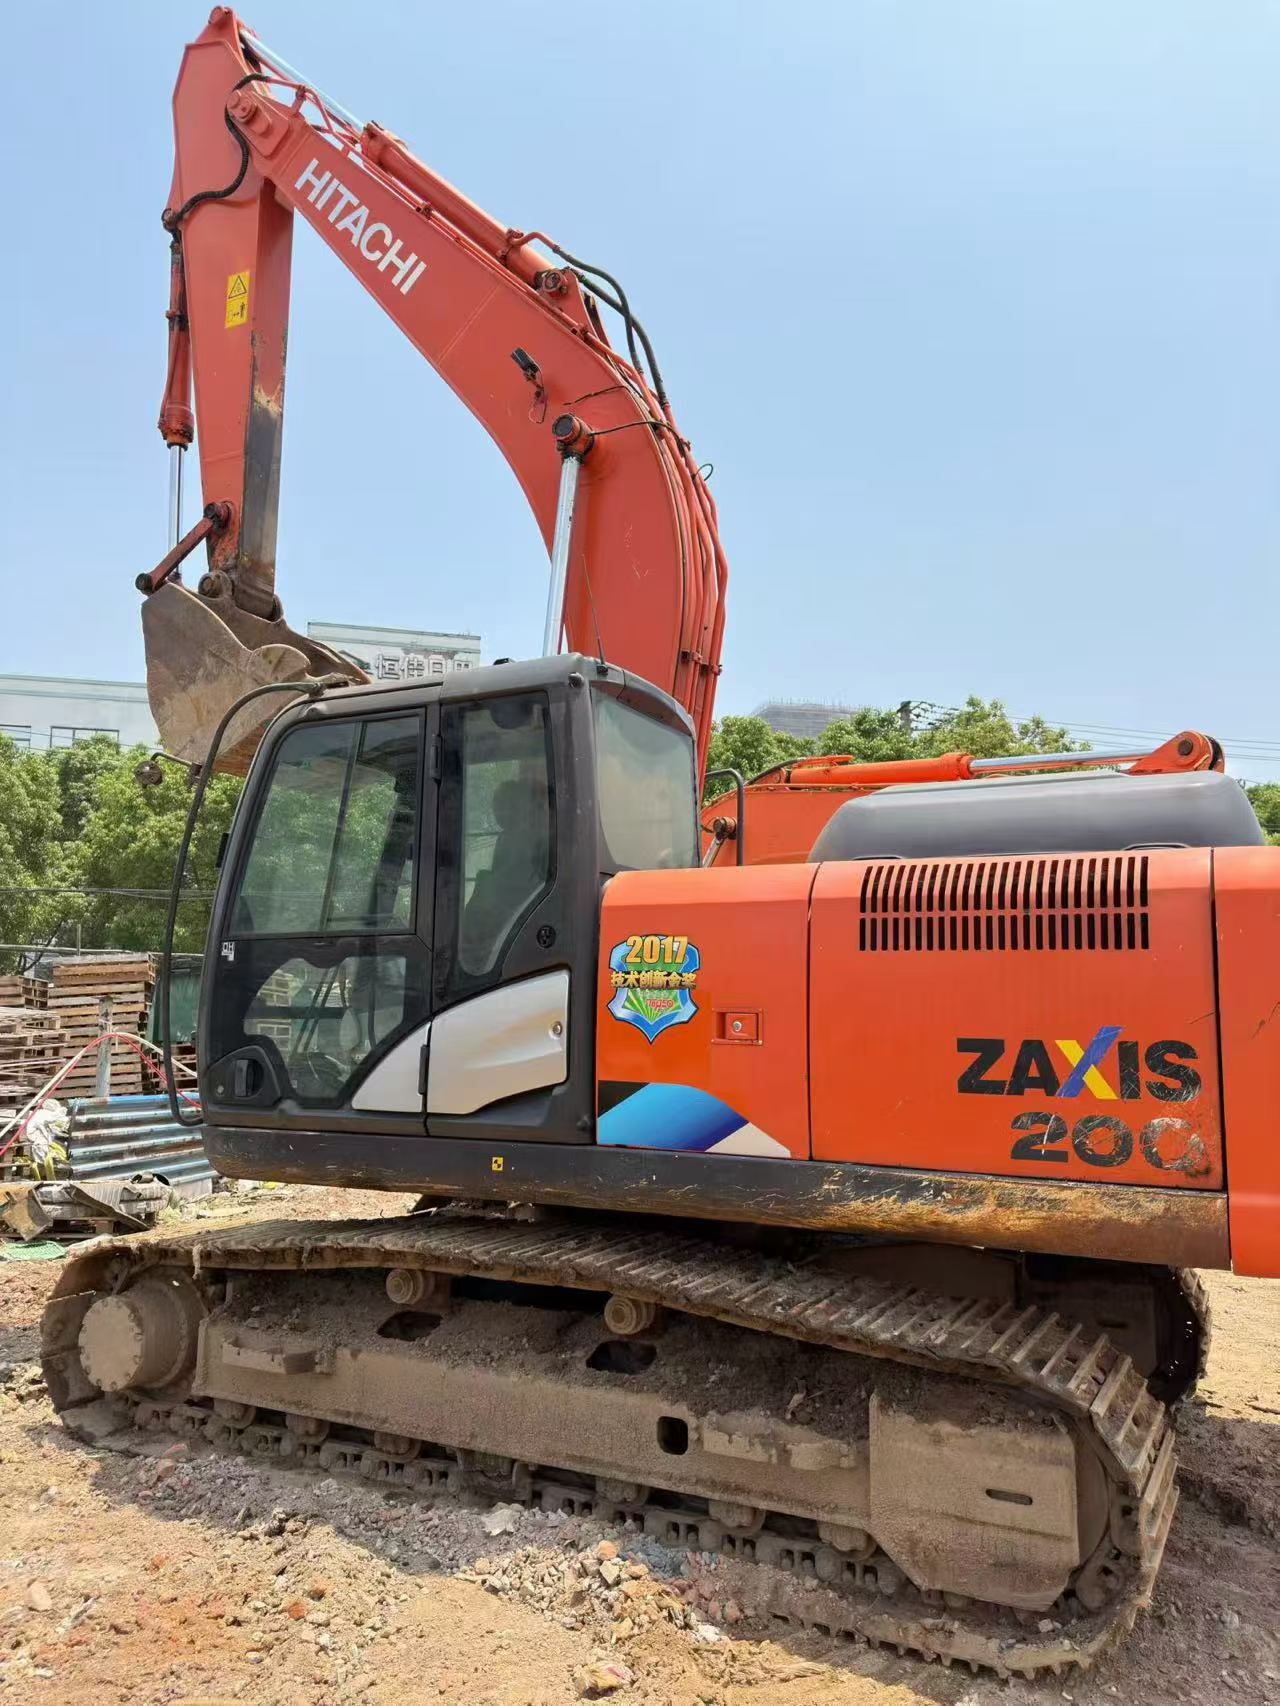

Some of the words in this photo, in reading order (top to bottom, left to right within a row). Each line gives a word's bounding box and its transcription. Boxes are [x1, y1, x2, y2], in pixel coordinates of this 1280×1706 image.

[294, 157, 427, 295] HITACHI
[610, 970, 697, 989] 技术创新金奖
[625, 934, 688, 964] 2017
[956, 1025, 1202, 1103] ZAXIS
[1010, 1111, 1206, 1172] 200
